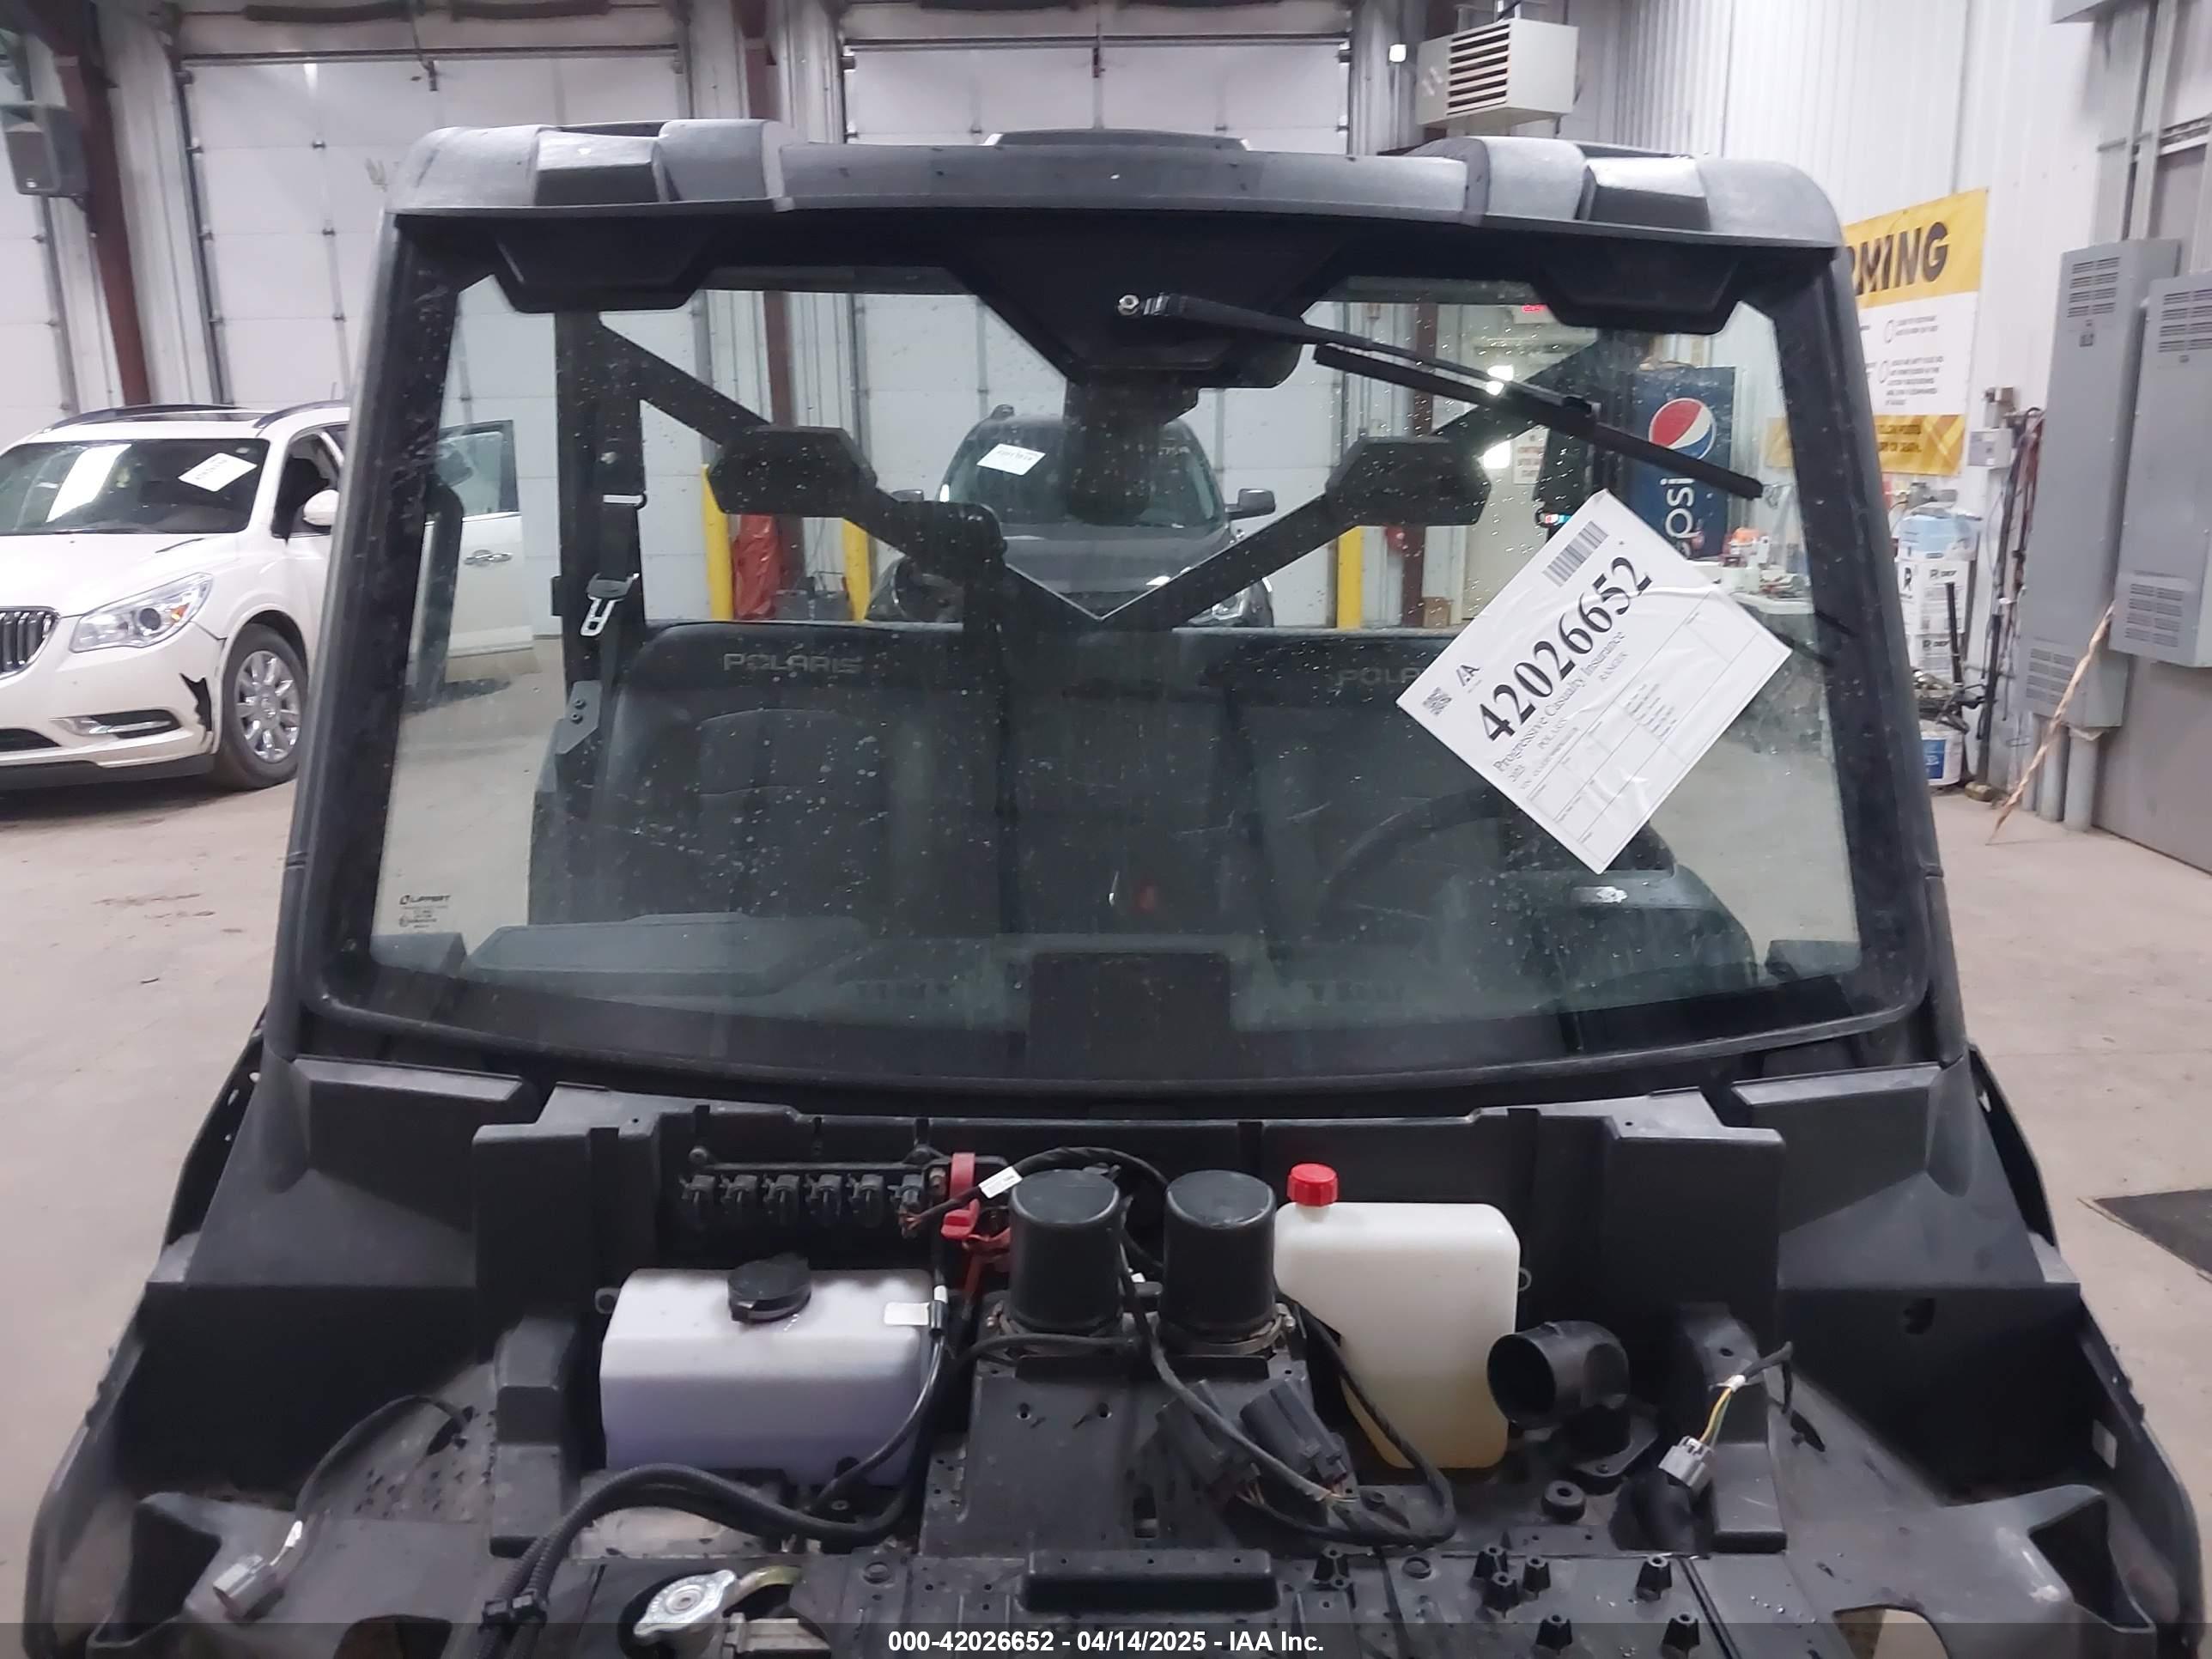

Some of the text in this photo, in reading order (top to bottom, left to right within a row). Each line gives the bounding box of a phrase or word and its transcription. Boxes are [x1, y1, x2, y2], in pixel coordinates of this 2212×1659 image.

[723, 653, 864, 673] POLARIS
[1479, 556, 1654, 743] 42026652
[1492, 716, 1551, 774] Progressive
[1544, 675, 1587, 719] Casualty
[1579, 630, 1627, 678] Insurance
